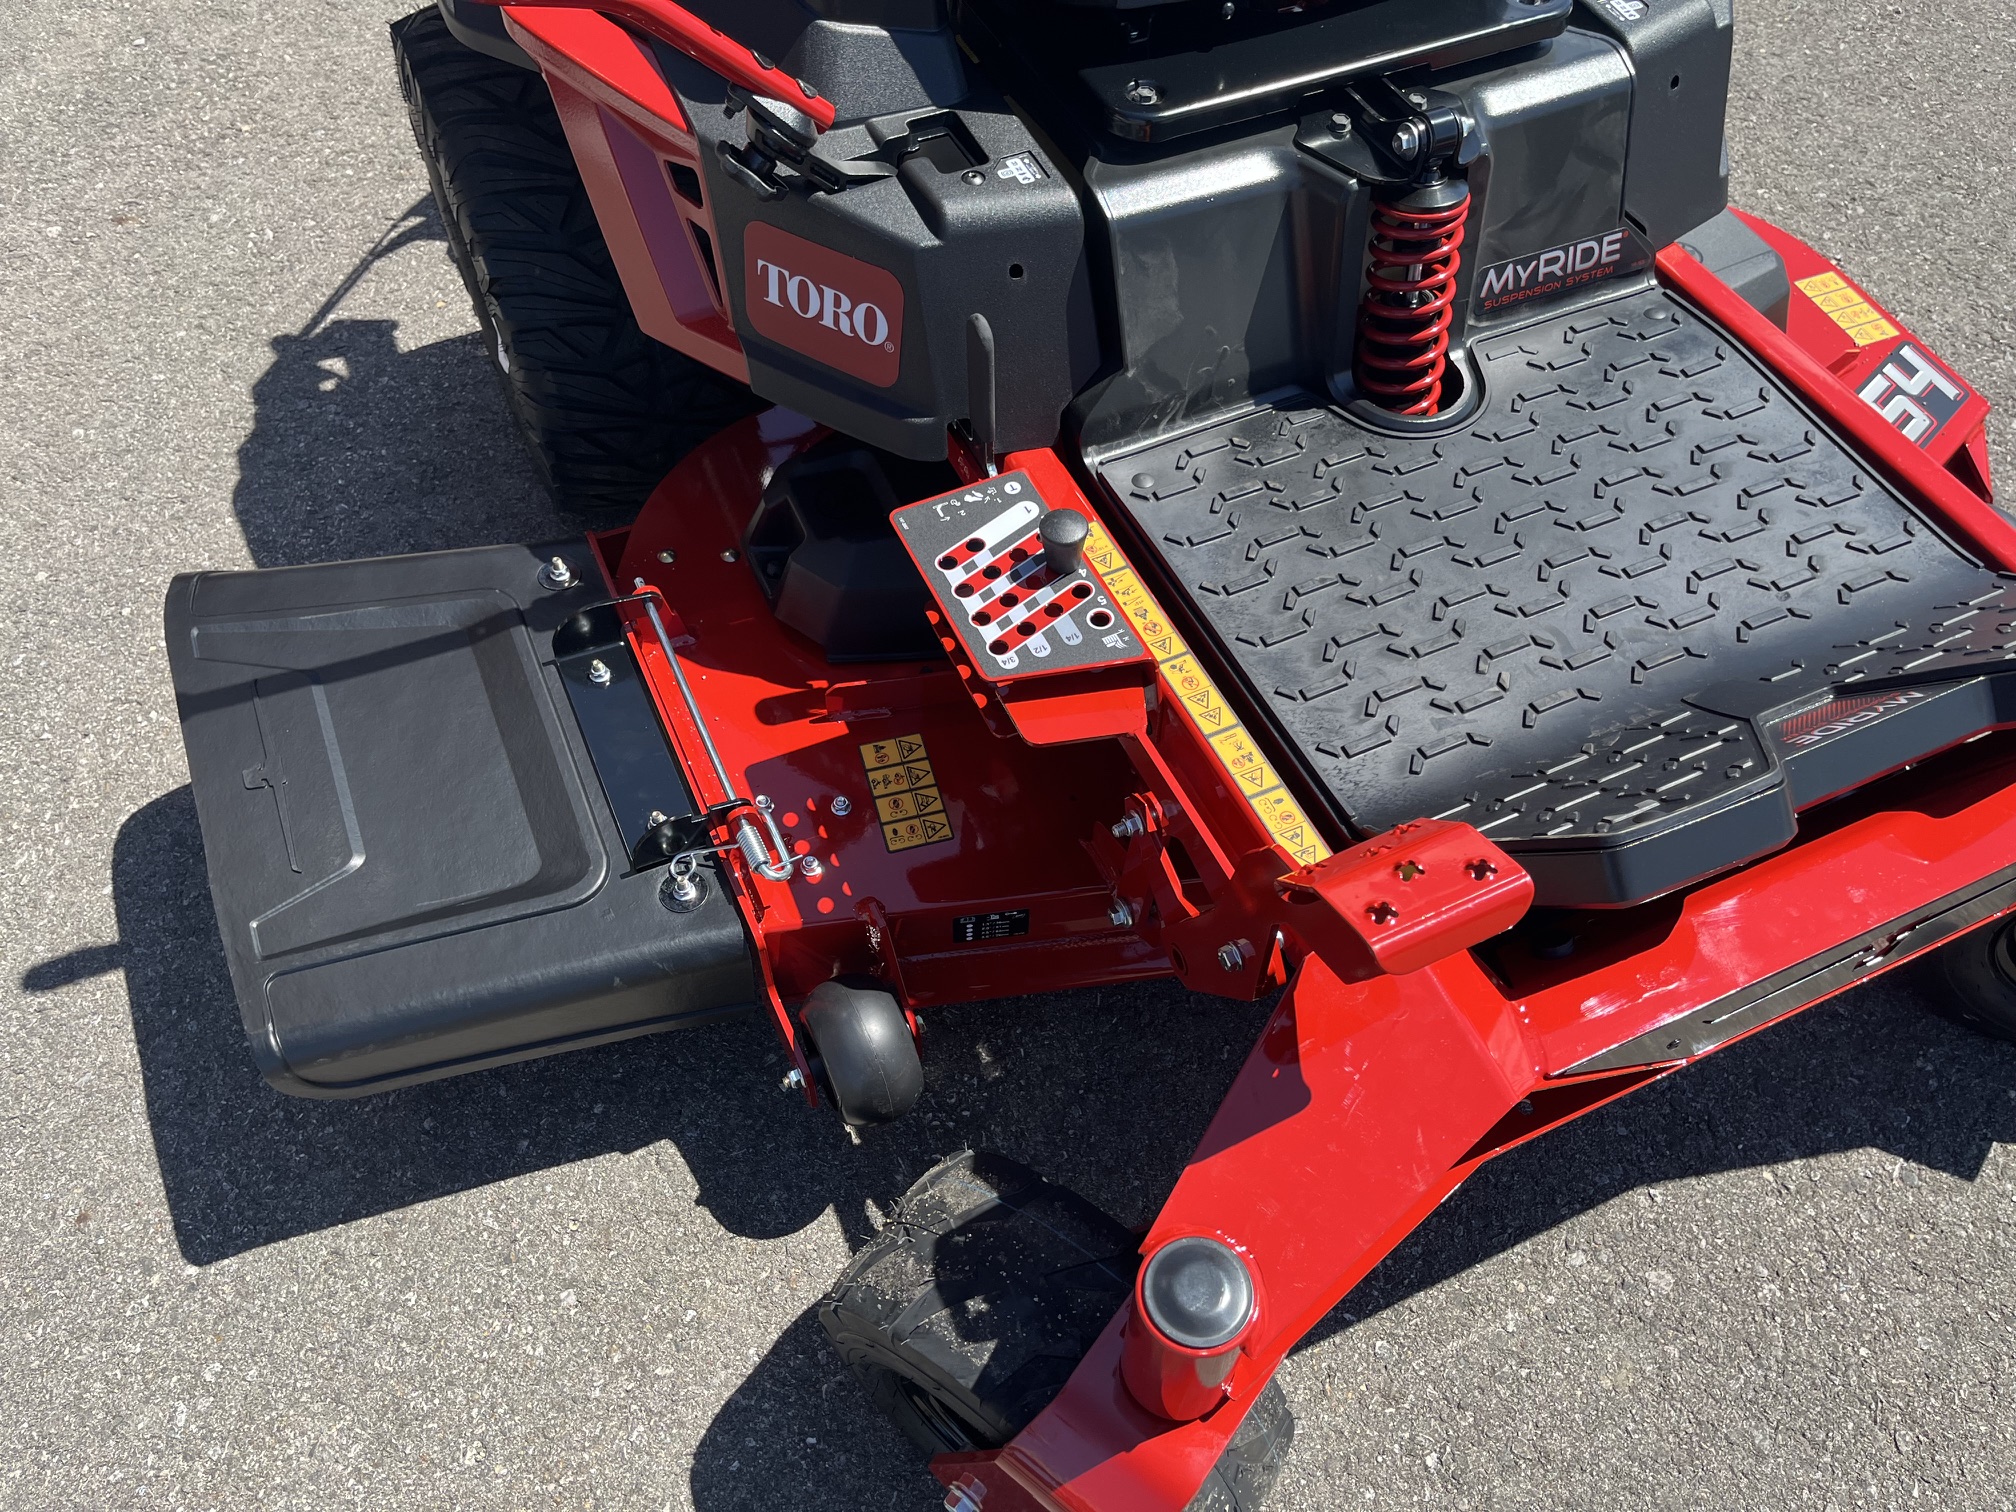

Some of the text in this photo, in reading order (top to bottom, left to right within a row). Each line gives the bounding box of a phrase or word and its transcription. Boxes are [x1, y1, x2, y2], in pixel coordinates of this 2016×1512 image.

[1484, 265, 1614, 310] SUSPENSION SYSTEM
[1857, 344, 1962, 443] 54
[1078, 568, 1087, 577] 4
[1097, 595, 1107, 606] 5
[1065, 632, 1080, 642] 1/4
[1033, 644, 1048, 654] 1/2
[1001, 656, 1016, 666] 3/4
